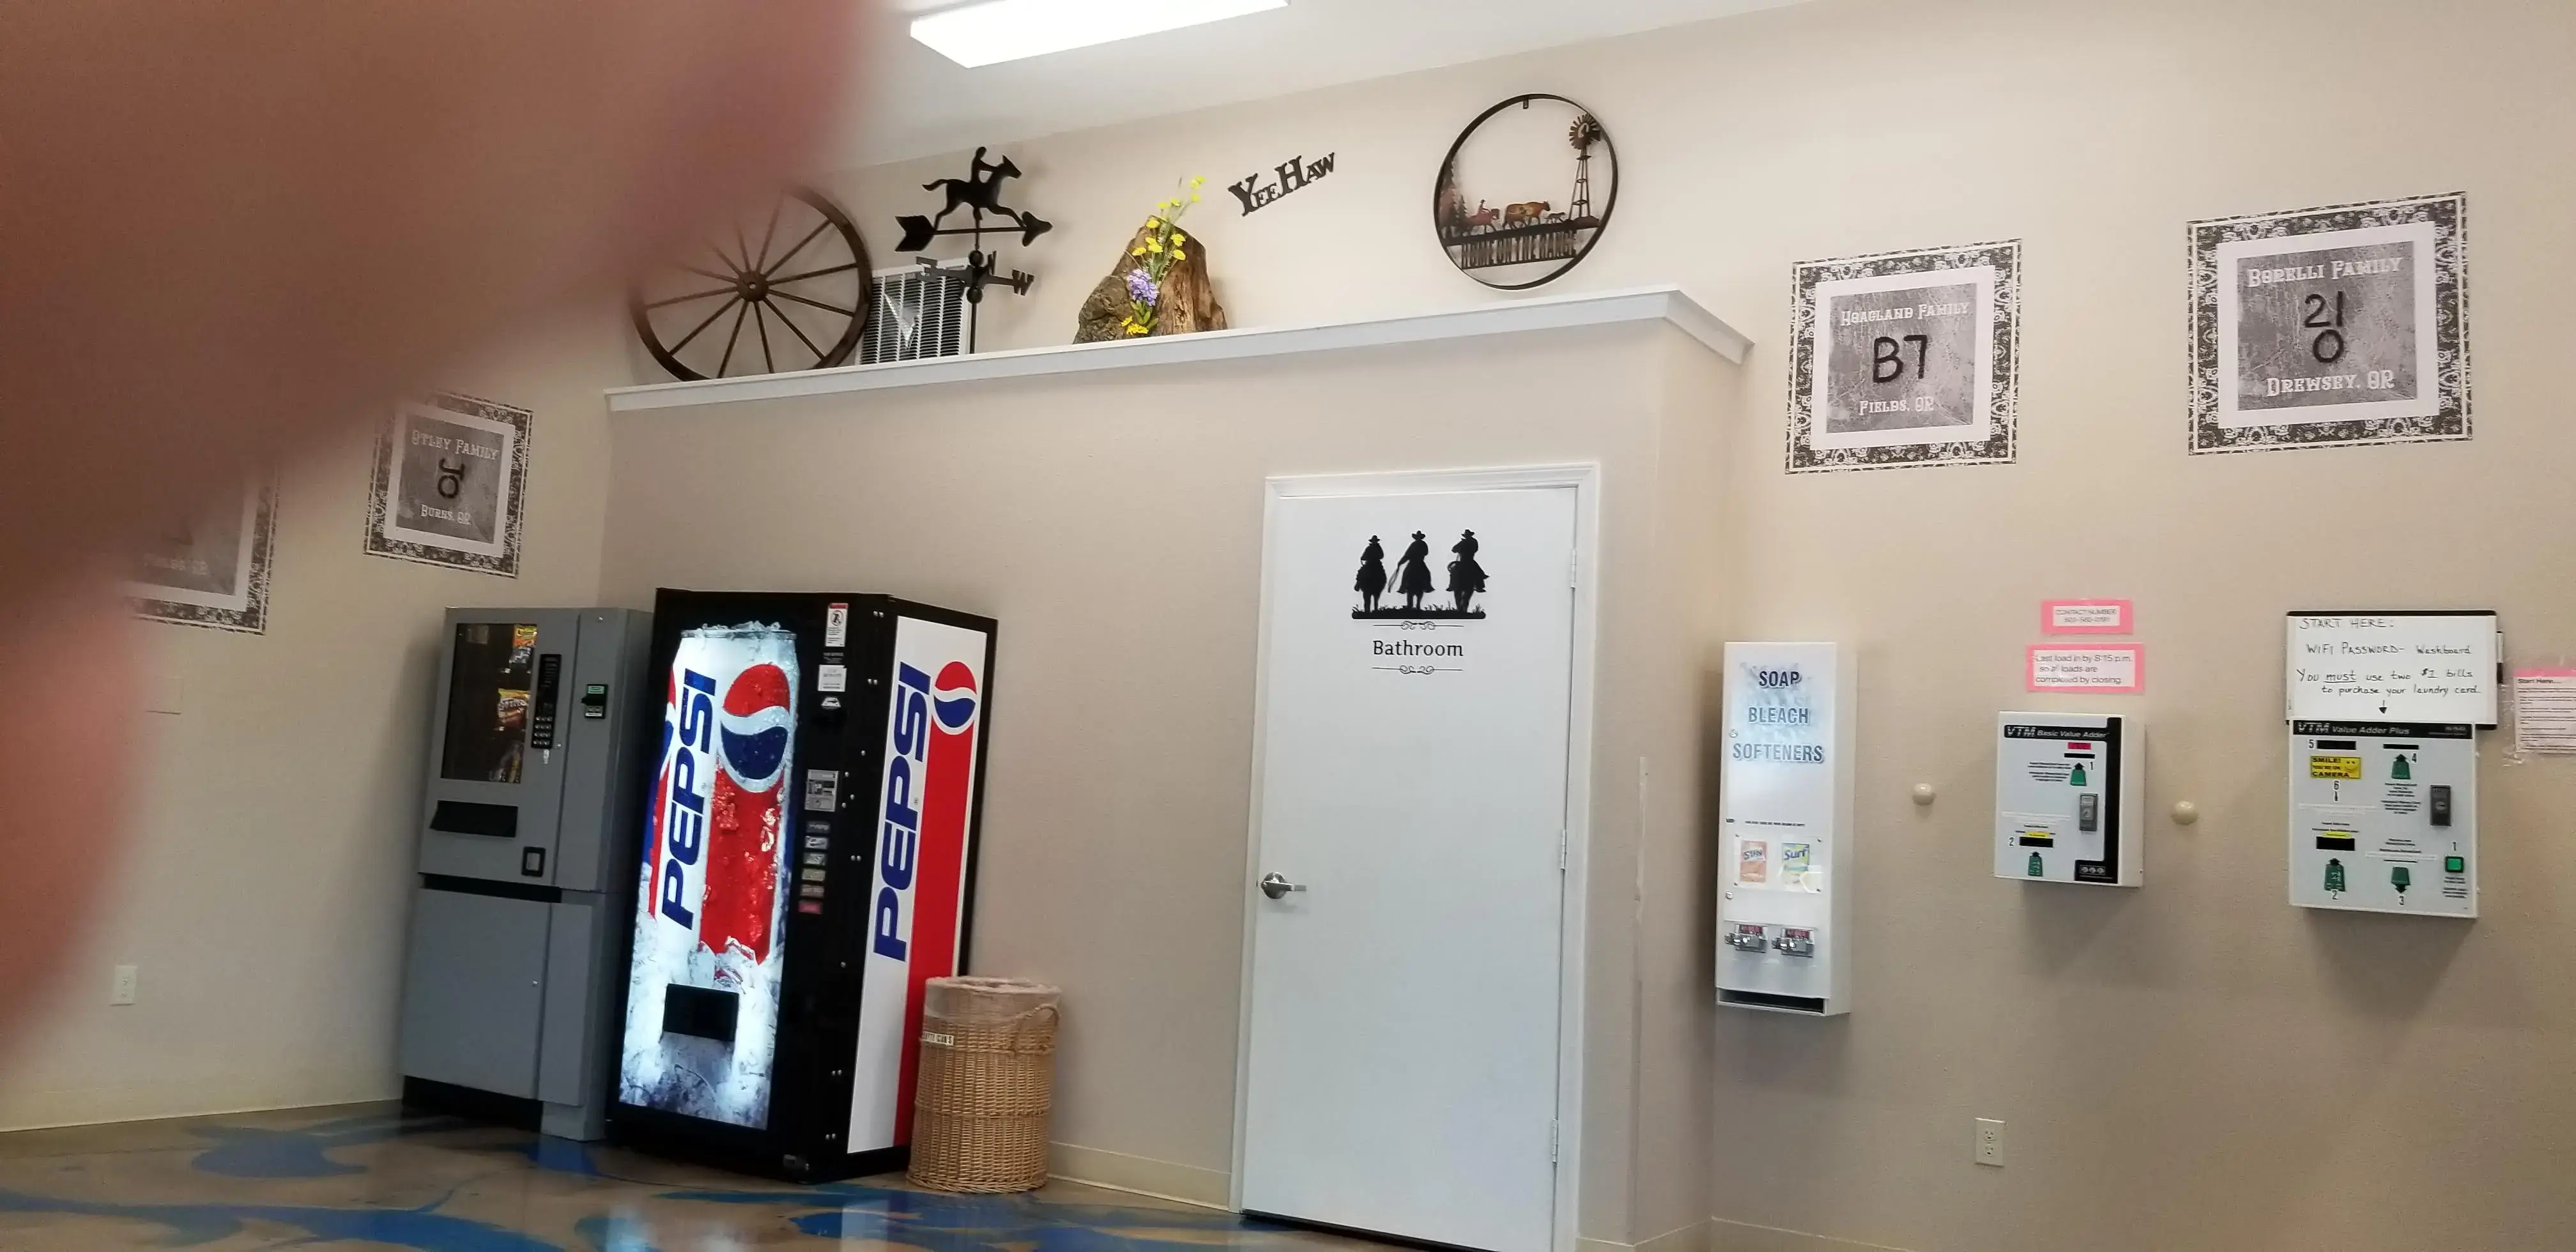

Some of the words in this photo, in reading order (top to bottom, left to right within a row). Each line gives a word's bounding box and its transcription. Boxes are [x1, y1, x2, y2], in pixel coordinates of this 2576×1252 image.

[2248, 265, 2325, 287] BORELLI
[2331, 257, 2403, 280] FAMILY
[1840, 307, 1913, 326] HOAGLAND
[1917, 302, 1970, 319] FAMILY
[1873, 334, 1928, 383] B7
[2367, 370, 2395, 389] OR
[1915, 396, 1935, 412] OR
[455, 438, 500, 460] FAMILY
[2299, 618, 2342, 629] START
[1373, 639, 1464, 657] Bathroom
[2082, 654, 2092, 664] by
[1758, 671, 1802, 688] SOAP
[2080, 676, 2090, 684] by
[2326, 670, 2356, 682] must
[2391, 671, 2411, 680] two
[2421, 668, 2438, 678] $1
[2446, 669, 2474, 678] bills
[2339, 685, 2380, 696] purchase
[2386, 687, 2406, 699] your
[2414, 684, 2449, 697] laundry
[1748, 706, 1810, 724] BLEACH
[1733, 743, 1825, 762] SOFTENERS
[2308, 740, 2315, 749] 5
[2334, 780, 2340, 790] 6
[661, 668, 717, 930] PEPSI
[873, 661, 932, 963] PEPSI
[2009, 837, 2015, 846] 2
[2331, 890, 2338, 900] 2
[2399, 896, 2405, 906] 3
